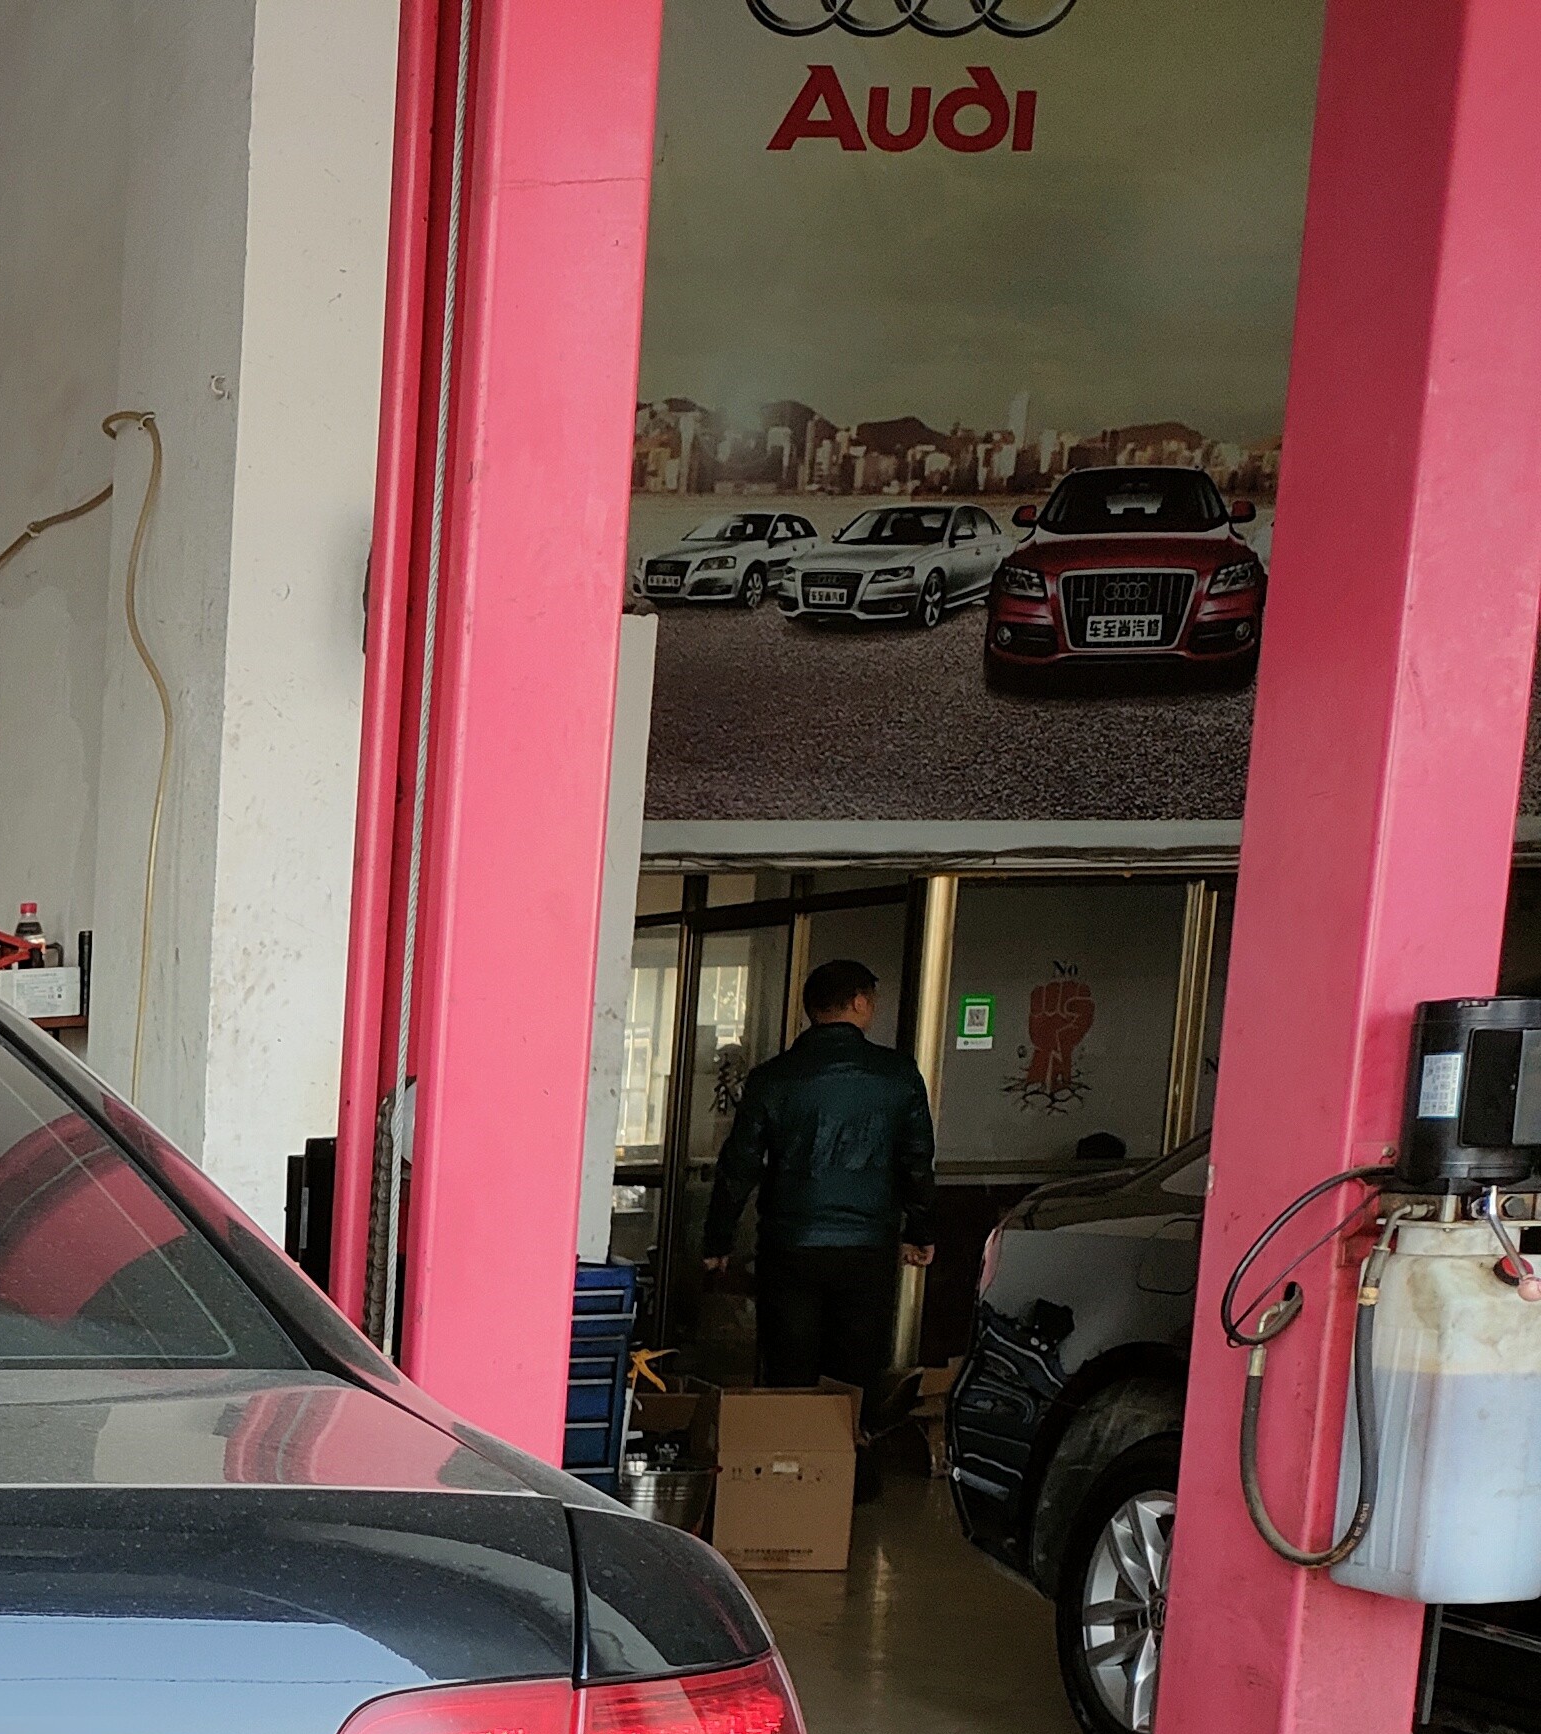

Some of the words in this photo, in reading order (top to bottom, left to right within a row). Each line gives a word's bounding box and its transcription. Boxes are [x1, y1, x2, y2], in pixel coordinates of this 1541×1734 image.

[766, 65, 1037, 152] Audi
[1089, 619, 1160, 638] 车至尚汽修
